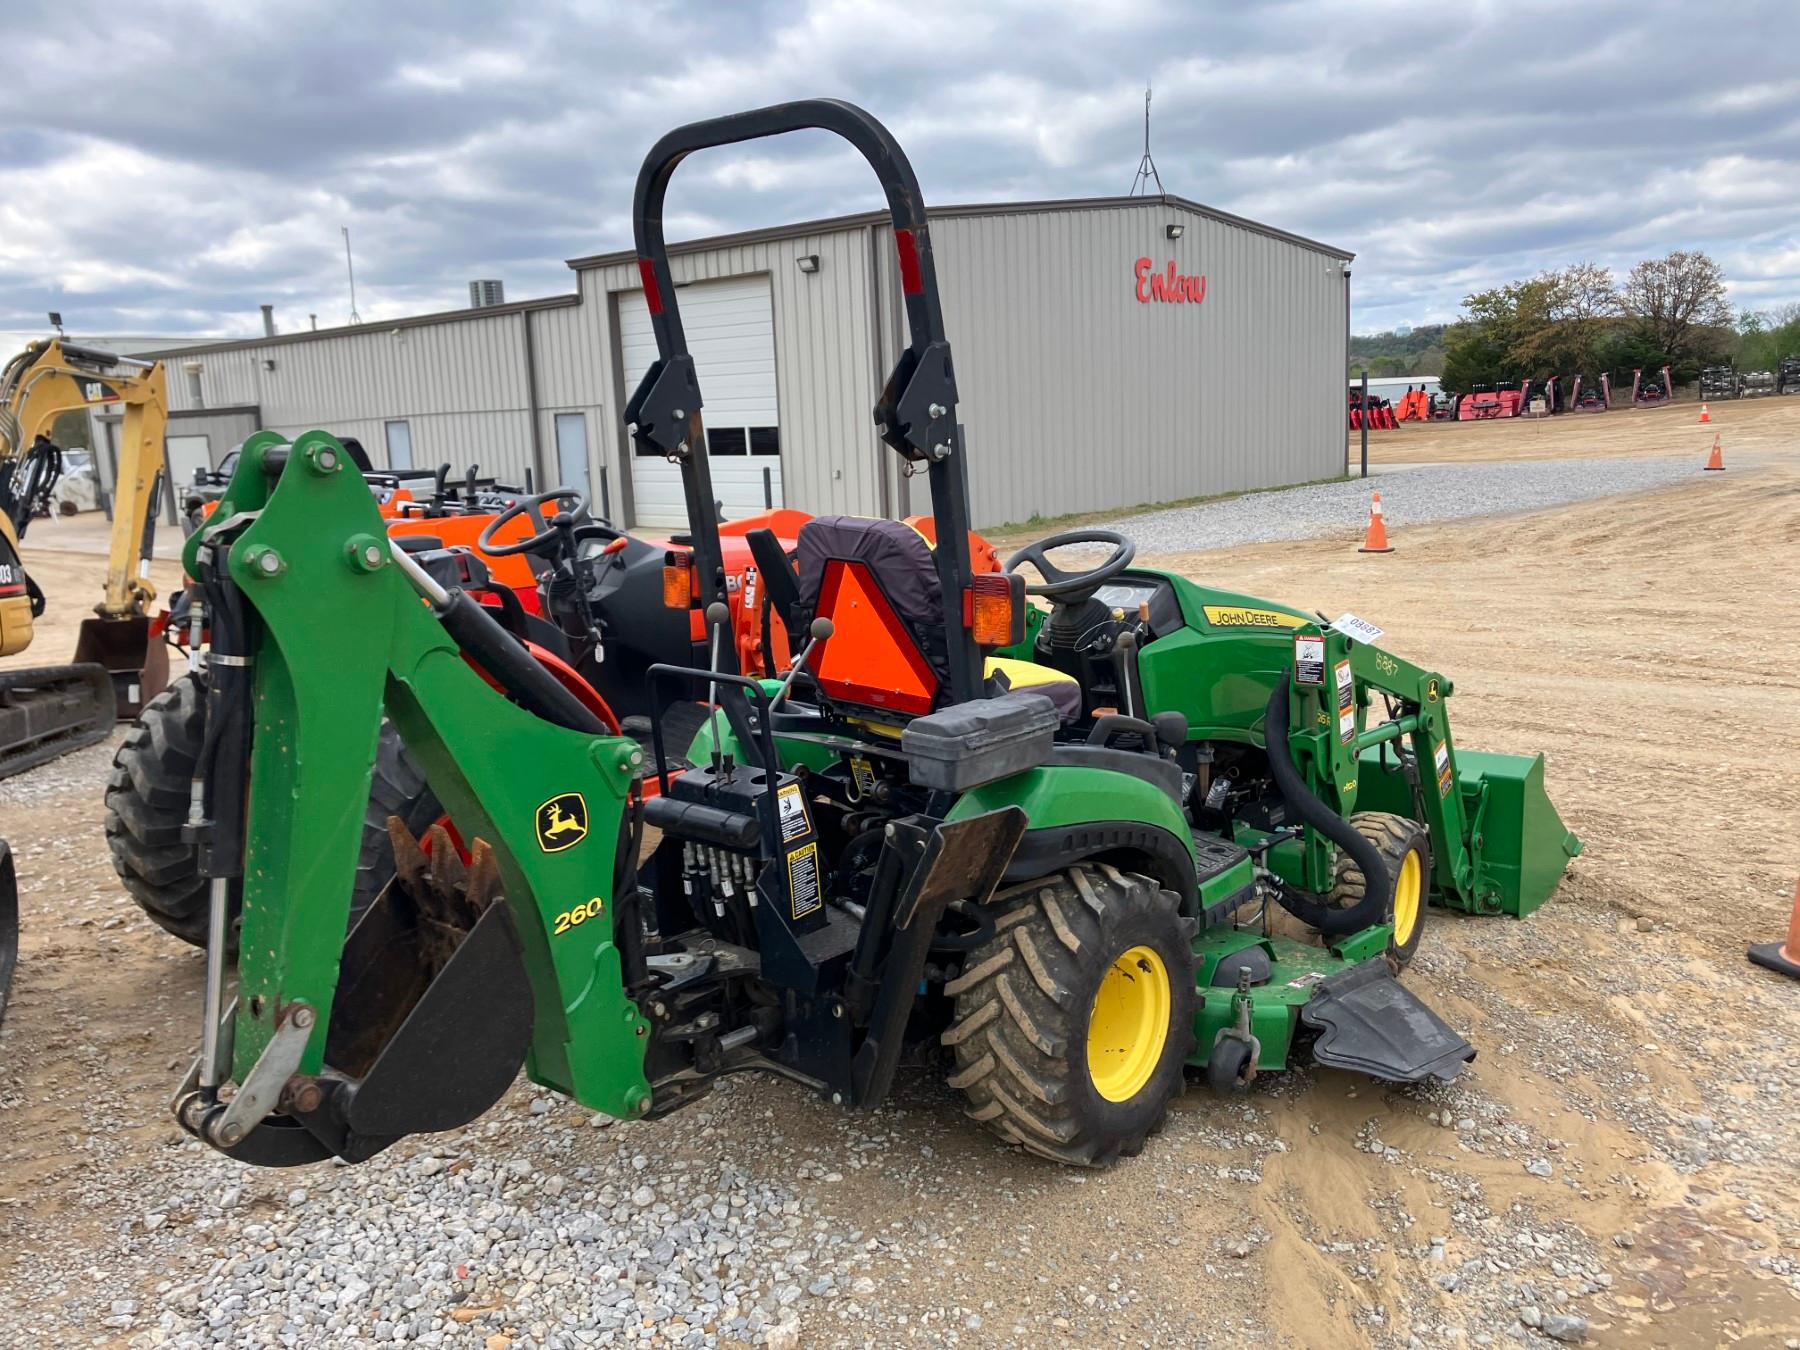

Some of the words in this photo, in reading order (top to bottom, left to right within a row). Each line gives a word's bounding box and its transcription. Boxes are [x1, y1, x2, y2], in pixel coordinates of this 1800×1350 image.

[1135, 256, 1207, 304] Enlow
[86, 382, 103, 401] CAT
[0, 564, 12, 584] 03
[1216, 611, 1244, 625] JOHN
[1245, 611, 1278, 625] DEERE
[553, 896, 603, 935] 260
